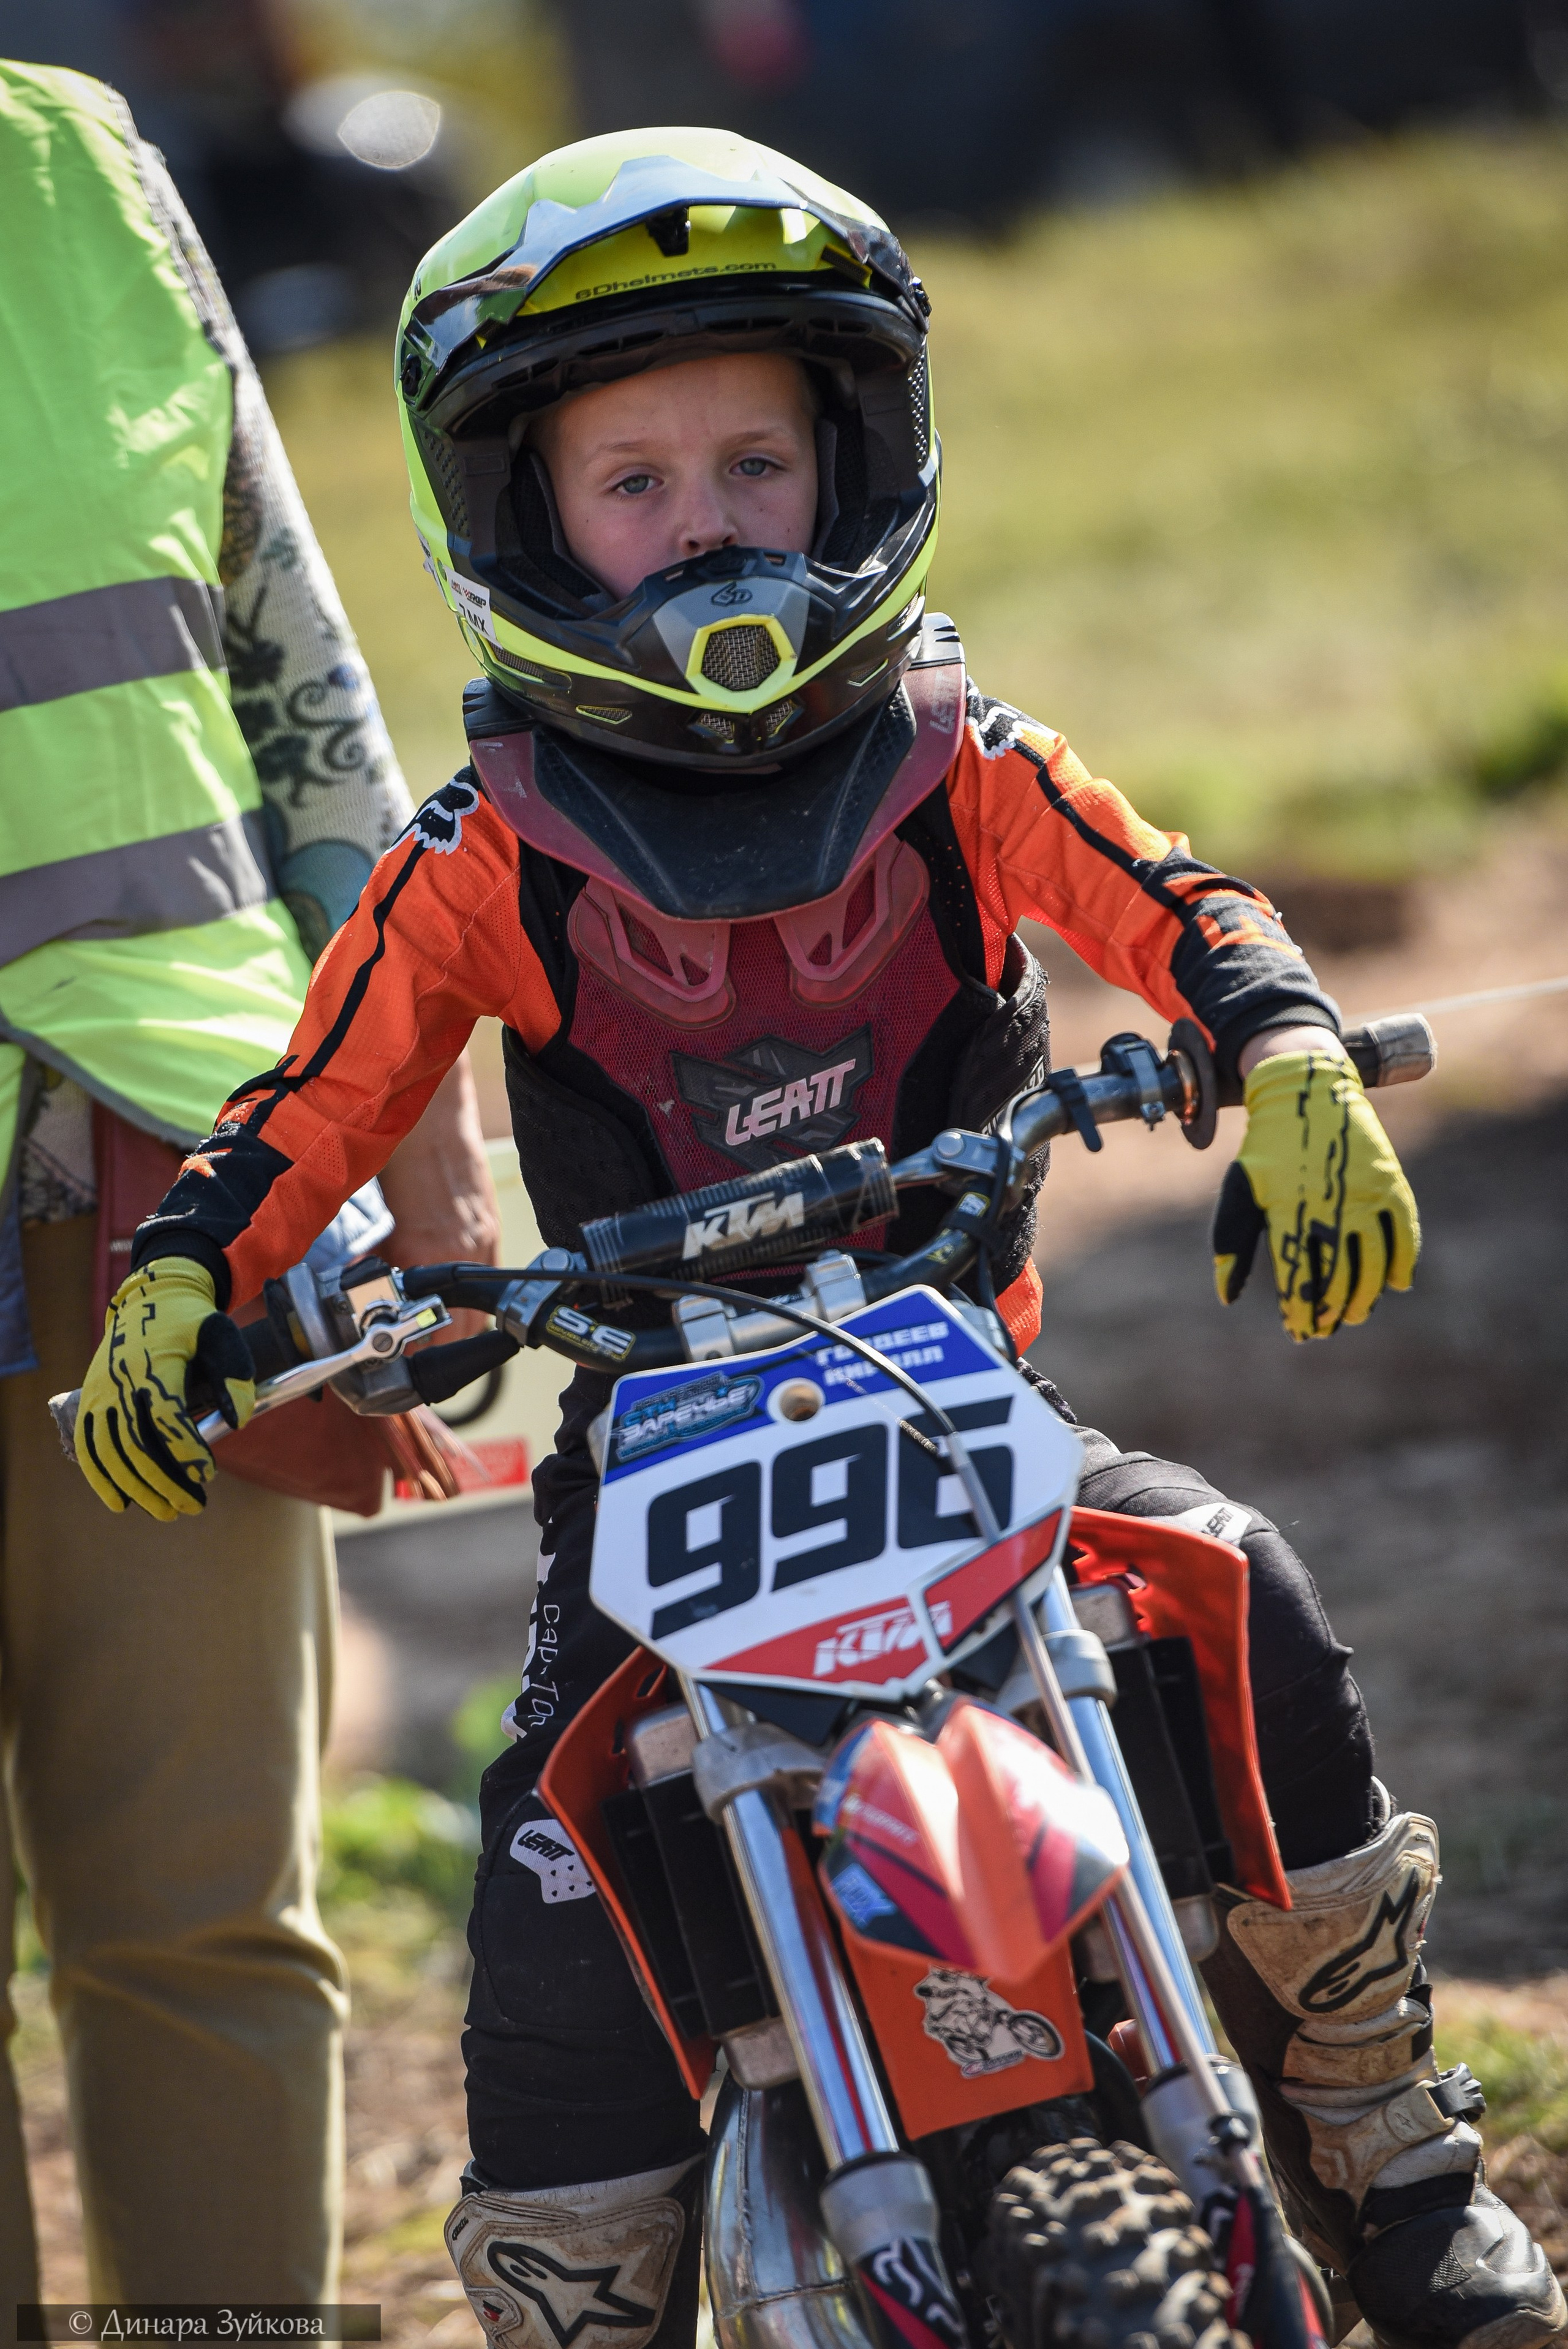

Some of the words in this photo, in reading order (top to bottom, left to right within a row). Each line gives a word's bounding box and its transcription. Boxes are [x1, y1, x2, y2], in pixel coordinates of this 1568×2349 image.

[575, 261, 777, 300] 6Dhelmets.com
[725, 1058, 856, 1146] LEATT
[682, 1192, 804, 1261] KTM
[647, 1396, 1014, 1641] 996
[1201, 1506, 1235, 1538] EATT
[813, 1599, 953, 1678] KTM
[518, 1829, 575, 1861] LEATT
